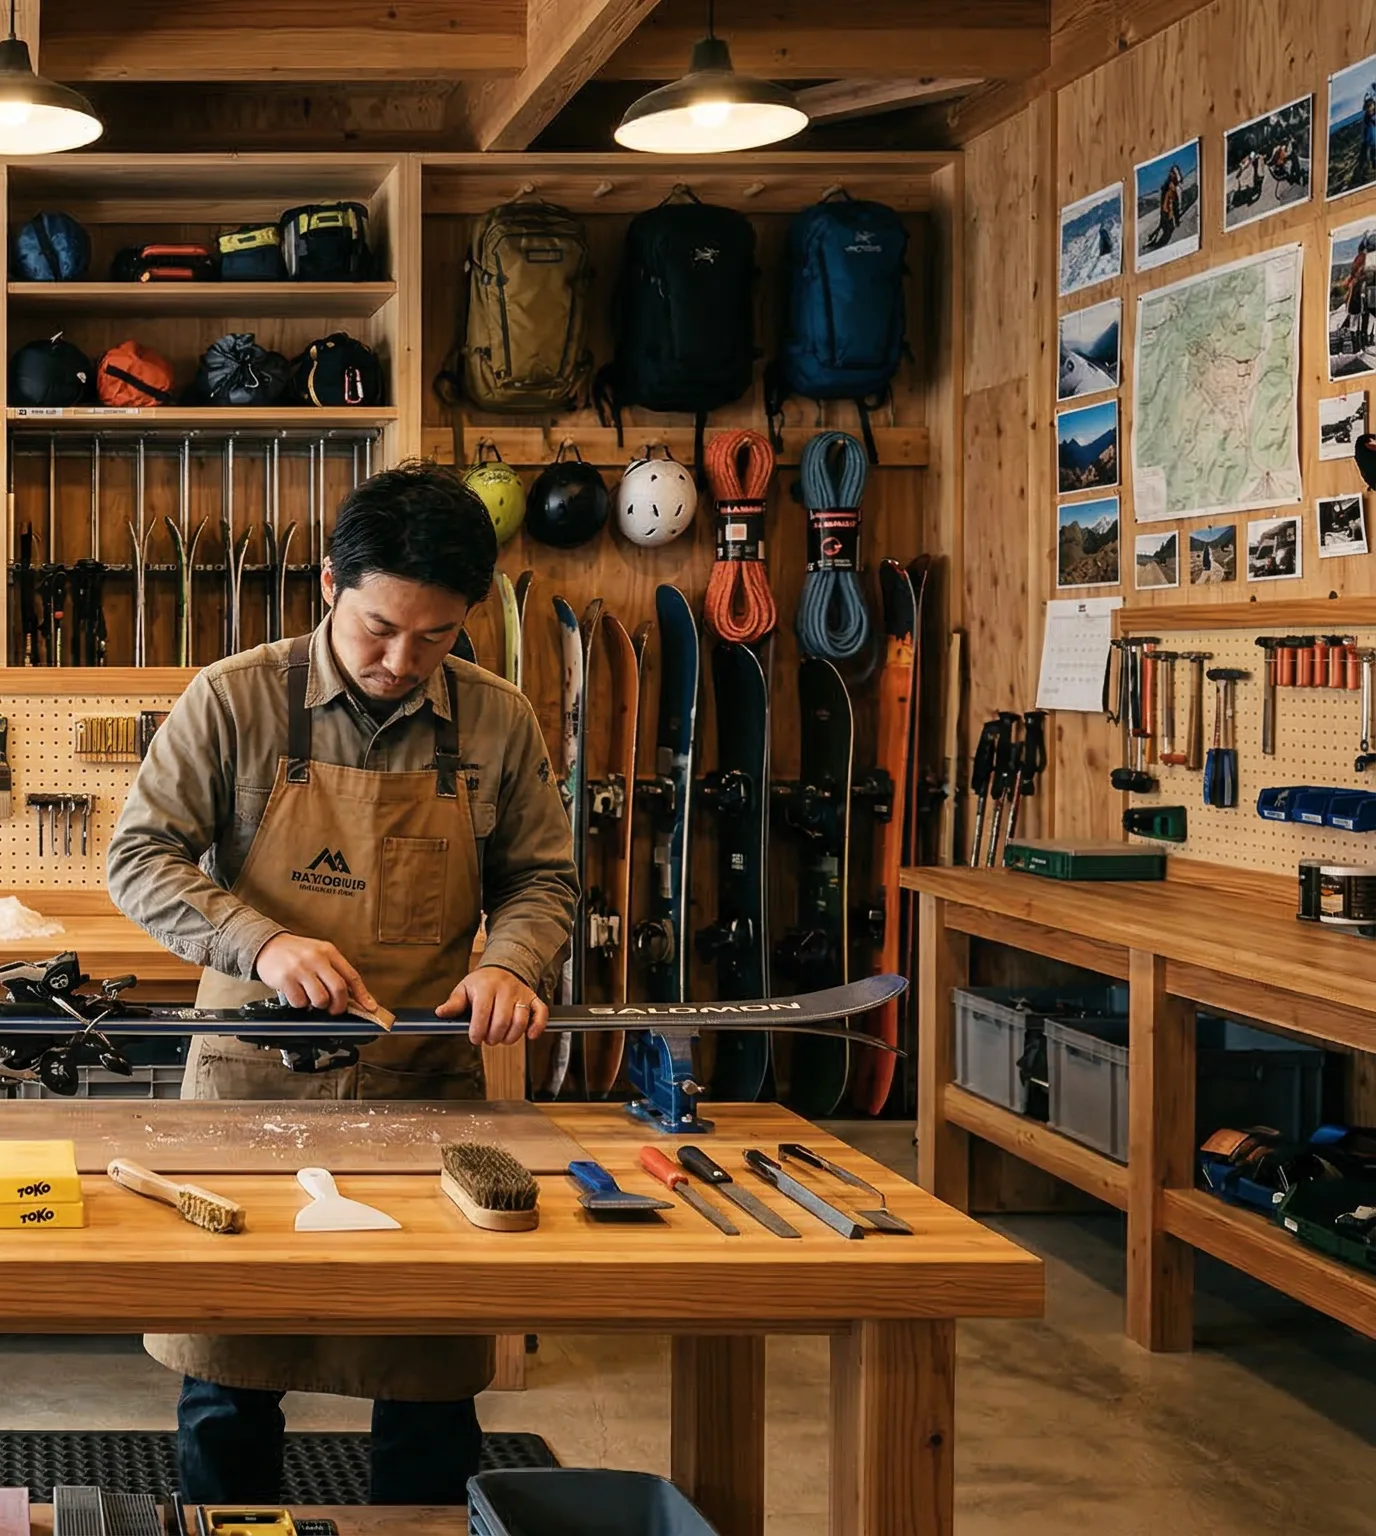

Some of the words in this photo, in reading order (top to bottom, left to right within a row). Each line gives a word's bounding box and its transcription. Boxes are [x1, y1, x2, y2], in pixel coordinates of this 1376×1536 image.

[588, 1002, 801, 1015] SALOMON
[17, 1181, 51, 1198] TOKO
[20, 1207, 55, 1224] TOKO
